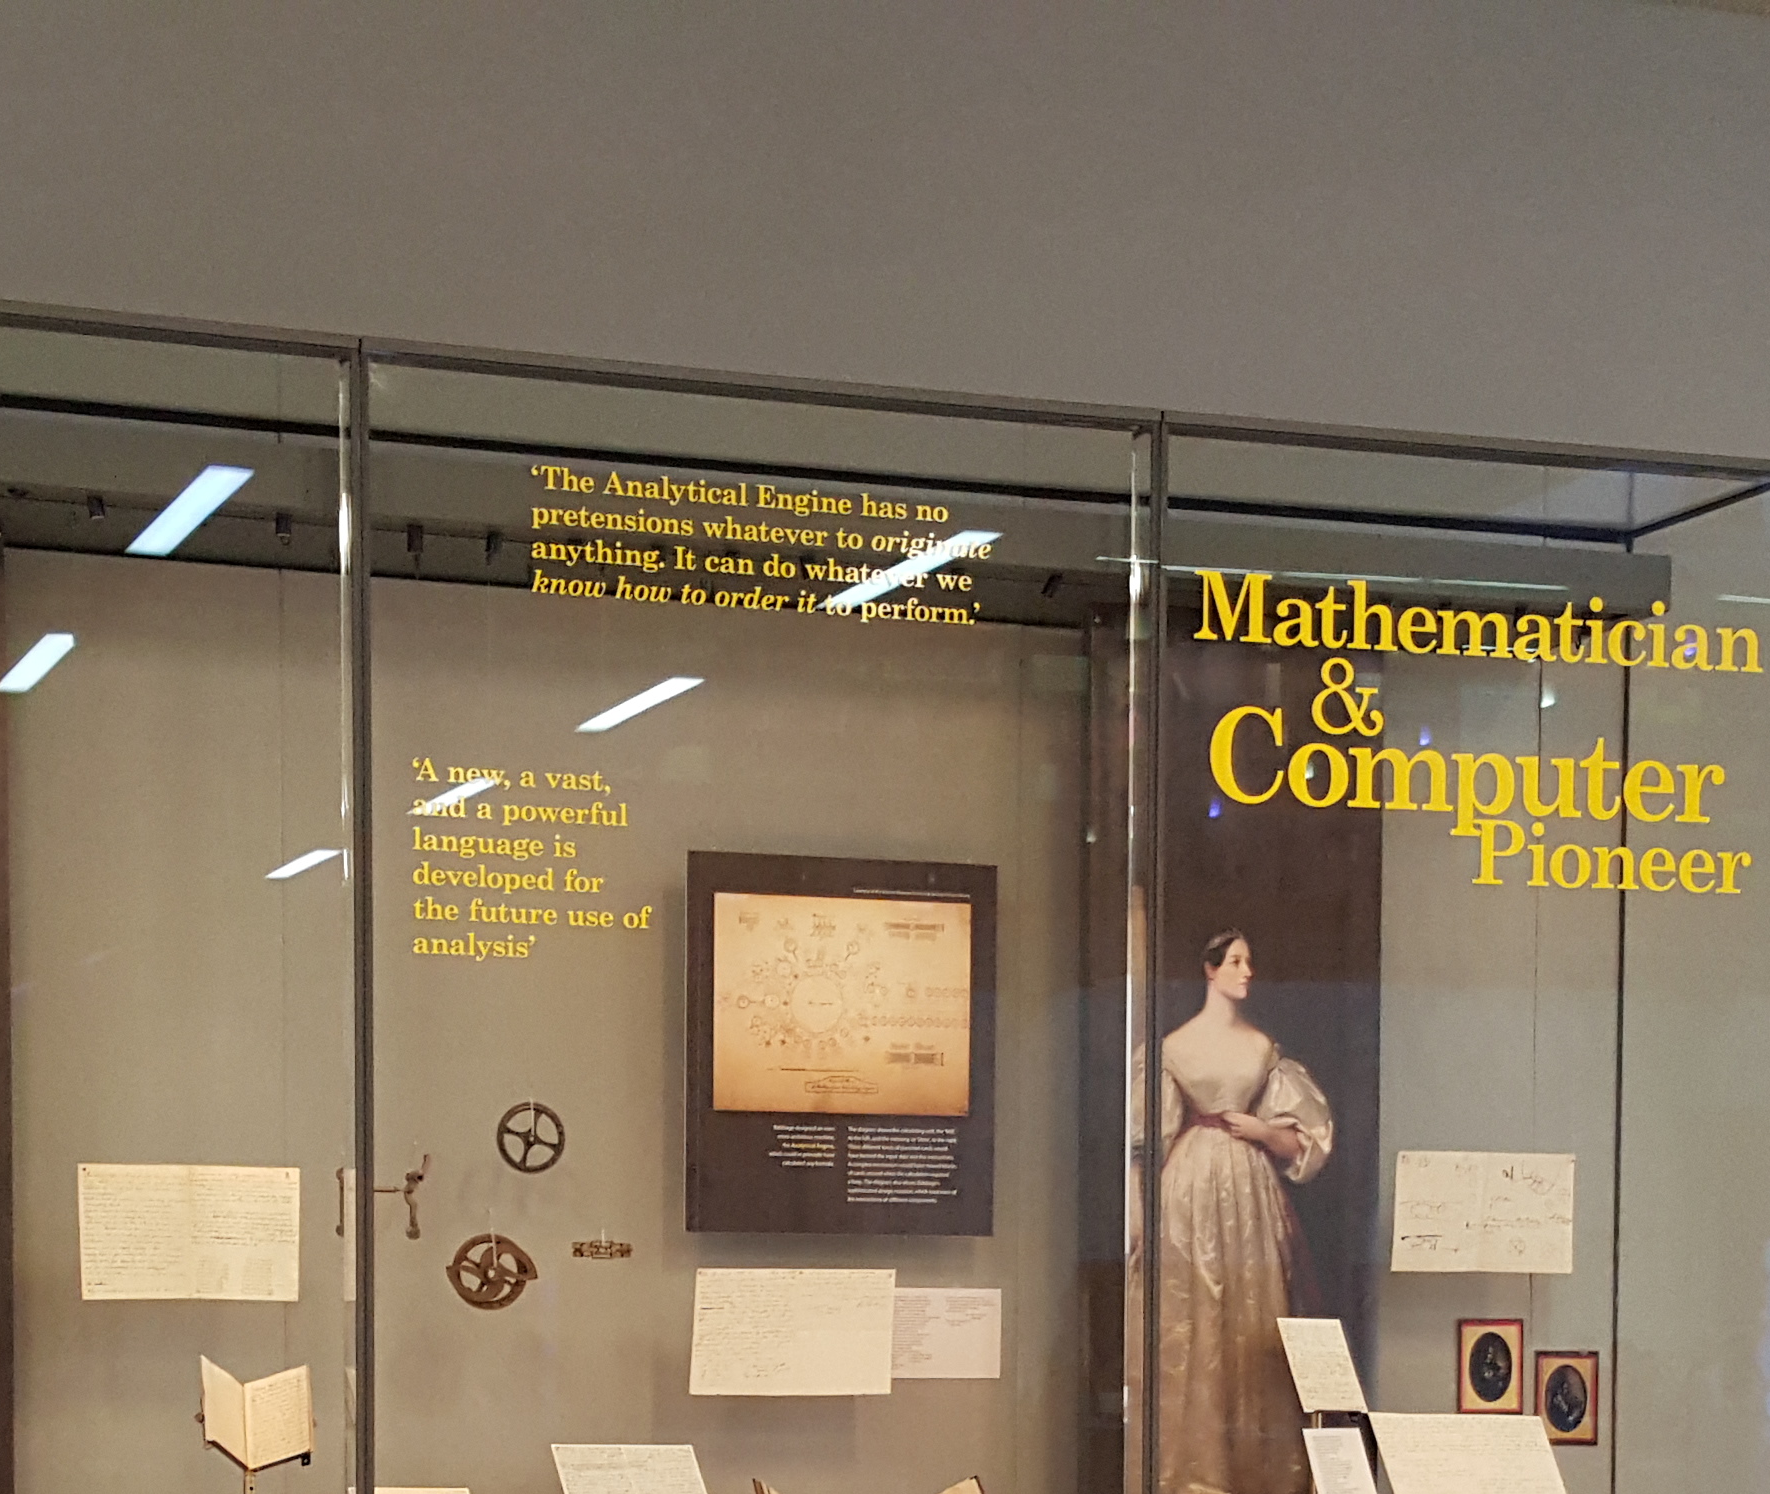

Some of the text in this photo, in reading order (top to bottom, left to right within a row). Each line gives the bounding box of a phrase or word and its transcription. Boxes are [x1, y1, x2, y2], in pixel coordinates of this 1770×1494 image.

[604, 472, 747, 507] Analytical
[757, 485, 852, 516] Engine
[861, 493, 907, 520] has
[916, 504, 949, 523] no
[531, 506, 694, 536] pretensions
[703, 517, 829, 548] whatever
[836, 528, 863, 549] to
[531, 538, 665, 572] anything.
[674, 546, 696, 570] It
[704, 556, 755, 576] can
[763, 558, 796, 579] do
[936, 573, 972, 591] we
[531, 571, 605, 599] know
[616, 577, 671, 602] how
[681, 584, 706, 605] to
[715, 586, 788, 611] order
[797, 591, 817, 613] it
[825, 594, 852, 616] to
[1193, 569, 1764, 673] Mathematician
[1311, 657, 1384, 737] &
[447, 766, 511, 790] new,
[519, 770, 536, 788] a
[545, 770, 611, 796] vast,
[1209, 705, 1725, 836] Computer
[412, 797, 628, 827] and a powerful
[412, 826, 577, 861] language is
[1471, 819, 1752, 894] Pioneer
[412, 861, 604, 894] developed for
[413, 896, 652, 929] the future use of
